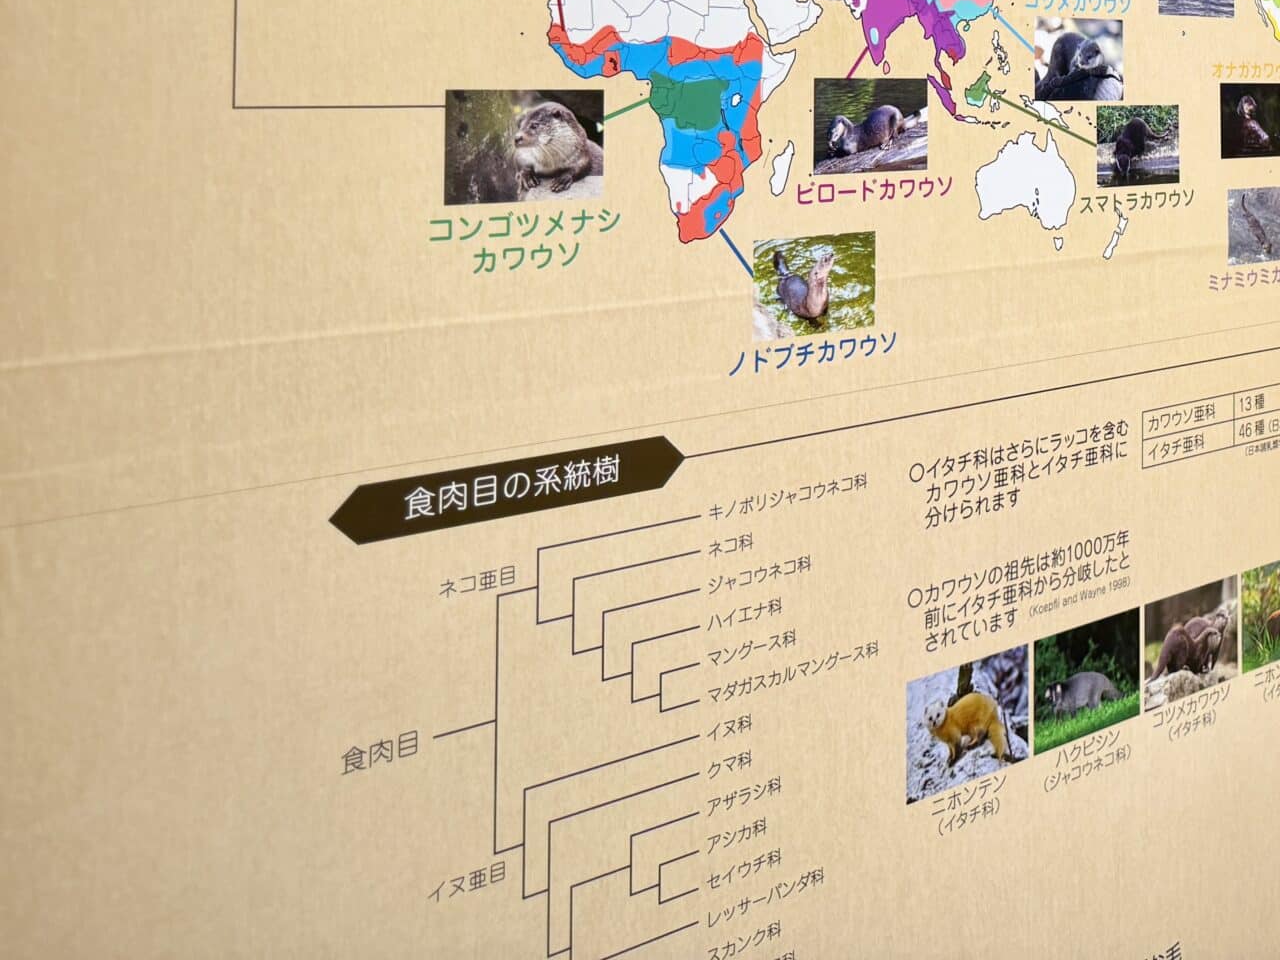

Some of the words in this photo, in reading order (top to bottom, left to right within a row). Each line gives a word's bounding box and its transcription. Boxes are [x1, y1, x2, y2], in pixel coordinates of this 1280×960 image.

[796, 176, 953, 205] ビロードカワウソ
[1080, 189, 1195, 214] スマトラカワウソ
[429, 208, 621, 242] コンゴツメナシ
[472, 242, 581, 274] カワウソ
[728, 332, 897, 377] ノドブチカワウソ
[1148, 402, 1216, 433] カワウソ亜科
[1148, 432, 1205, 461] イタチ亜科
[403, 453, 621, 521] 食肉目の系統樹
[926, 442, 1128, 503] カワウソ亜科とイタチ亜科に
[925, 489, 1021, 529] 分けられます
[708, 532, 754, 558] ネコ科
[439, 565, 517, 599] ネコ亜目
[708, 554, 811, 594] ジャコウネコ科
[924, 552, 1131, 630] 前にイタチ亜科から分岐したと
[707, 597, 782, 632] ハイエナ科
[925, 608, 1019, 652] されています
[708, 628, 796, 667] マングース科
[708, 640, 879, 704] マダガスカルマングース科
[1153, 683, 1231, 728] コツメカワウソ
[707, 713, 753, 742] イヌ科
[1168, 711, 1217, 742] （イタチ科）
[341, 730, 418, 775] 食肉目
[707, 749, 753, 779] クマ科
[1044, 744, 1132, 793] （ジャコウネコ科）
[1055, 730, 1120, 768] ハクビシン
[707, 776, 782, 816] アザラシ科
[931, 775, 1007, 816] ニホンテン
[707, 817, 768, 854] アシカ科
[938, 797, 1002, 837] （イタチ科）
[428, 861, 506, 902] イヌ亜目
[706, 848, 781, 890] セイウチ科
[708, 867, 825, 928] レッサーパンダ科
[707, 920, 781, 960] スカンク科
